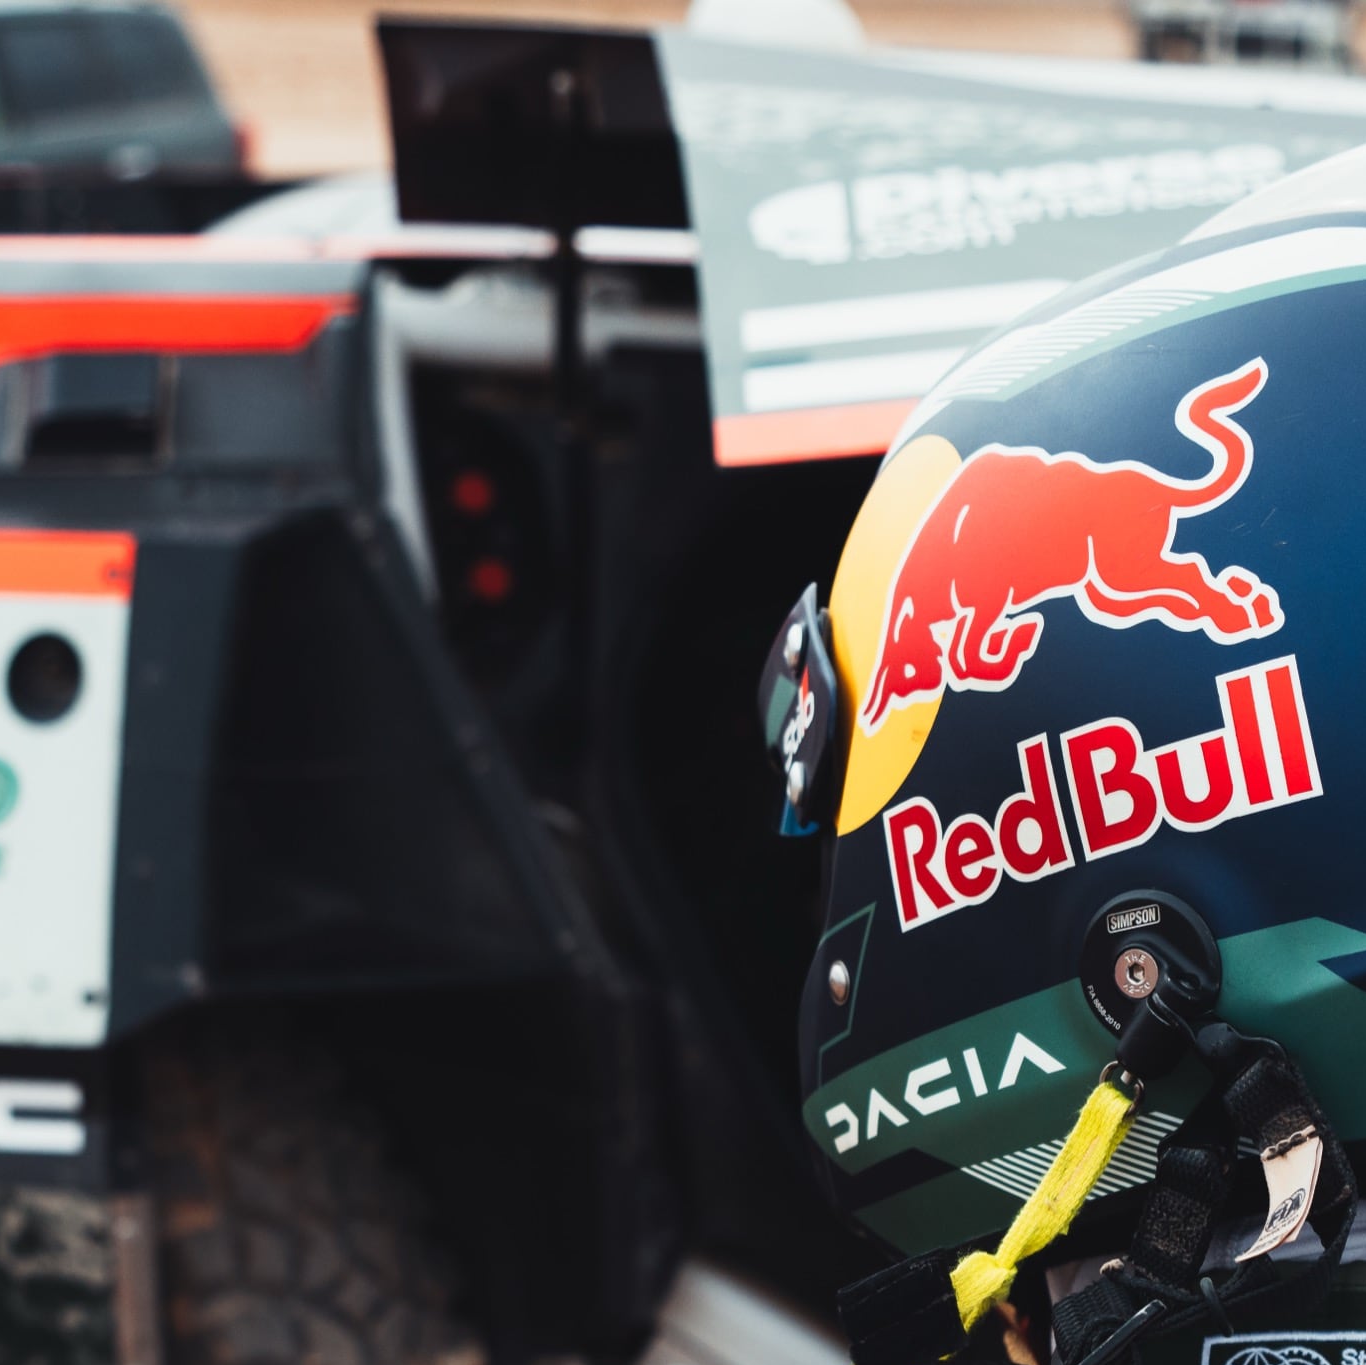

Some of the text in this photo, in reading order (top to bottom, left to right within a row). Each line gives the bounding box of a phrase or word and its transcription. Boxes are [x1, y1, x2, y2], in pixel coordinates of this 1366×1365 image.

[885, 658, 1319, 929] Red Bull
[1110, 907, 1156, 930] SIMPSON
[1087, 985, 1096, 999] FIA
[825, 1031, 1067, 1155] DACIA
